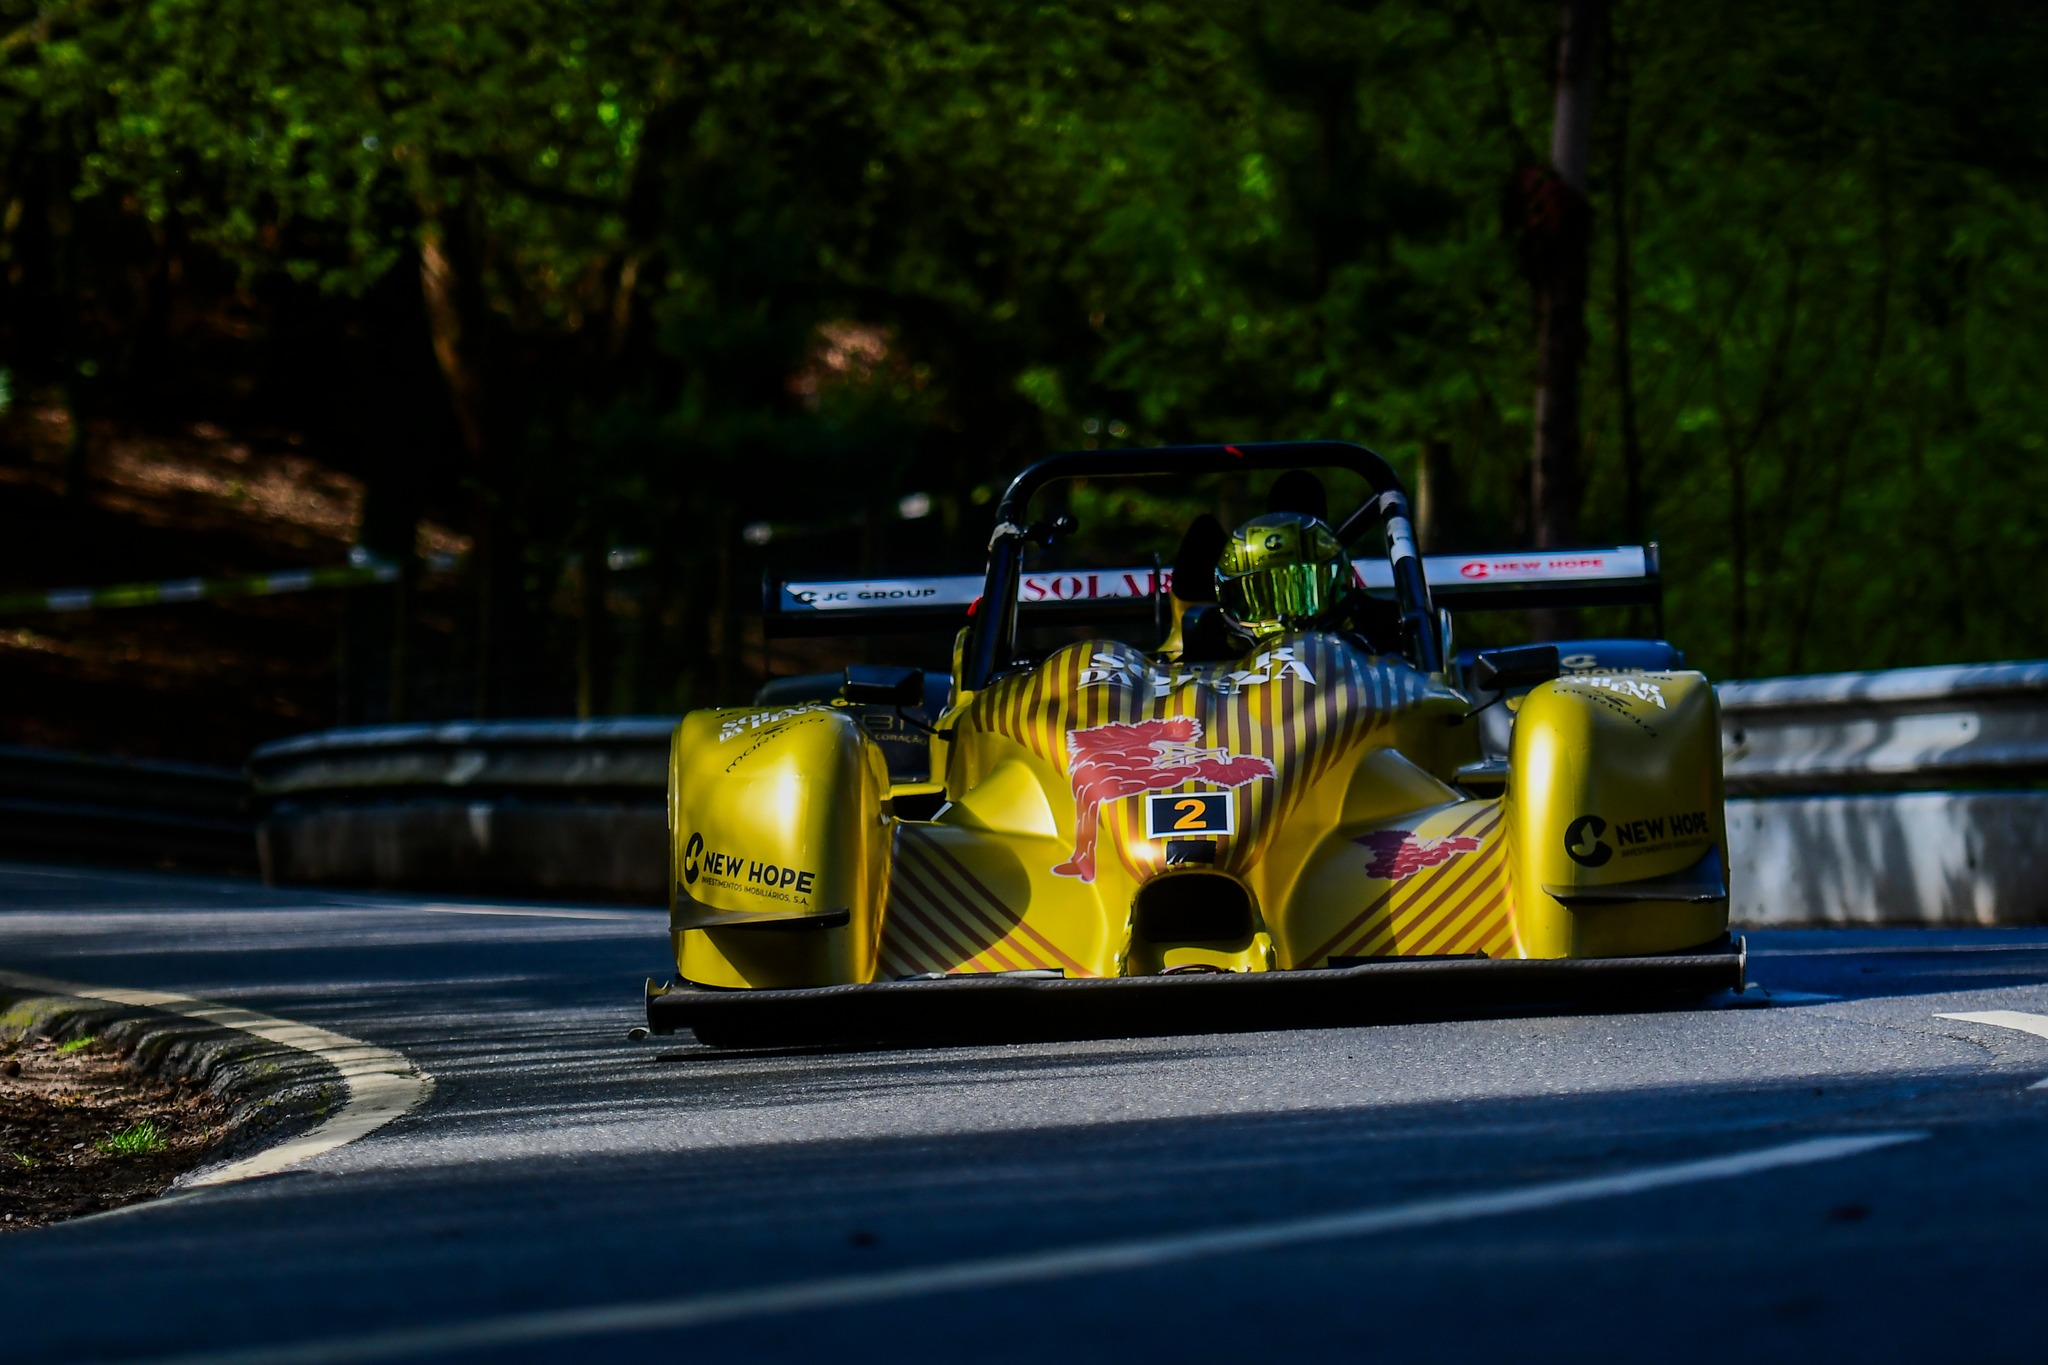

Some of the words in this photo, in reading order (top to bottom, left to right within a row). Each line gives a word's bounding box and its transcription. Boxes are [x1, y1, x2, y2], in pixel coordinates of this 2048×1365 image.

[1493, 562, 1541, 571] NEW
[1548, 559, 1604, 569] HOPE
[823, 591, 848, 602] JC
[857, 588, 937, 601] GROUP
[1078, 669, 1133, 690] DA
[1173, 799, 1207, 830] 2
[1615, 816, 1665, 847] NEW
[1669, 811, 1709, 838] HOPE
[703, 850, 744, 878] NEW
[748, 861, 816, 894] HOPE
[702, 877, 743, 892] INVESTIMENTOS
[793, 895, 810, 906] S.A.
